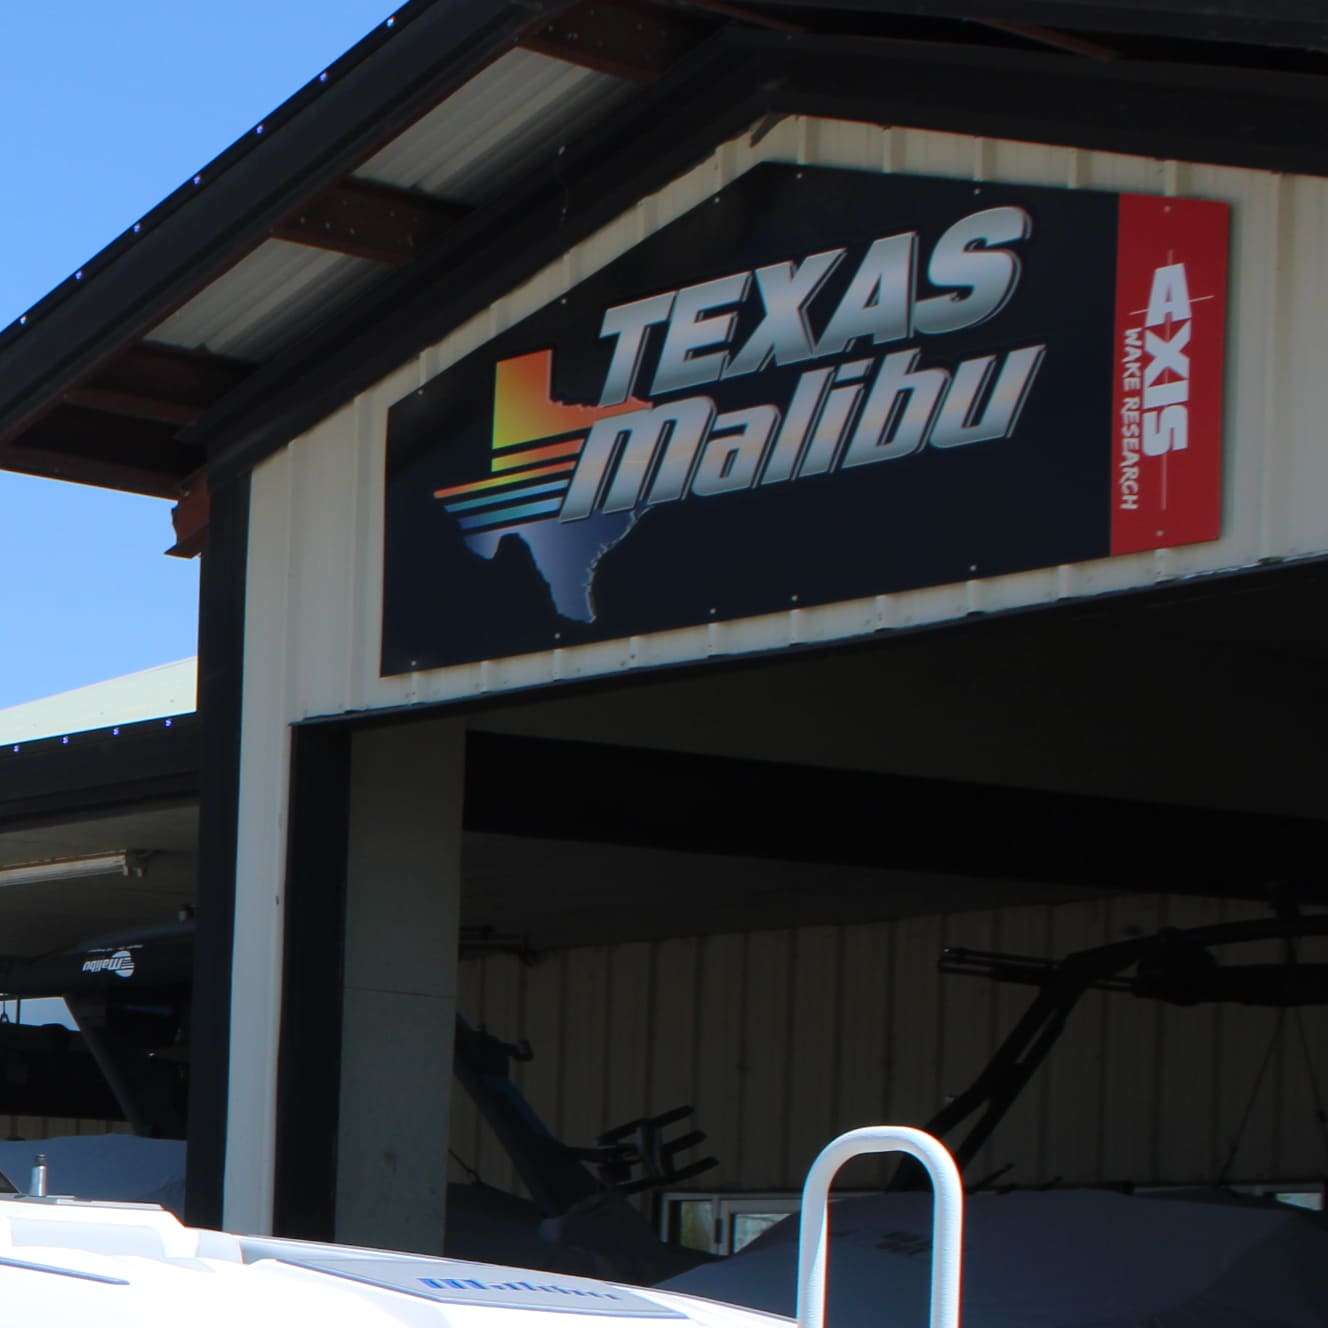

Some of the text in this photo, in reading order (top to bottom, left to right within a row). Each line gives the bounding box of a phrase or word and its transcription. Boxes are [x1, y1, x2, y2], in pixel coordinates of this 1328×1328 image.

[598, 206, 1033, 409] TEXAS
[1143, 262, 1193, 457] AXIS
[559, 345, 1046, 523] Malibu
[1119, 327, 1144, 511] WAKE RESEARCH
